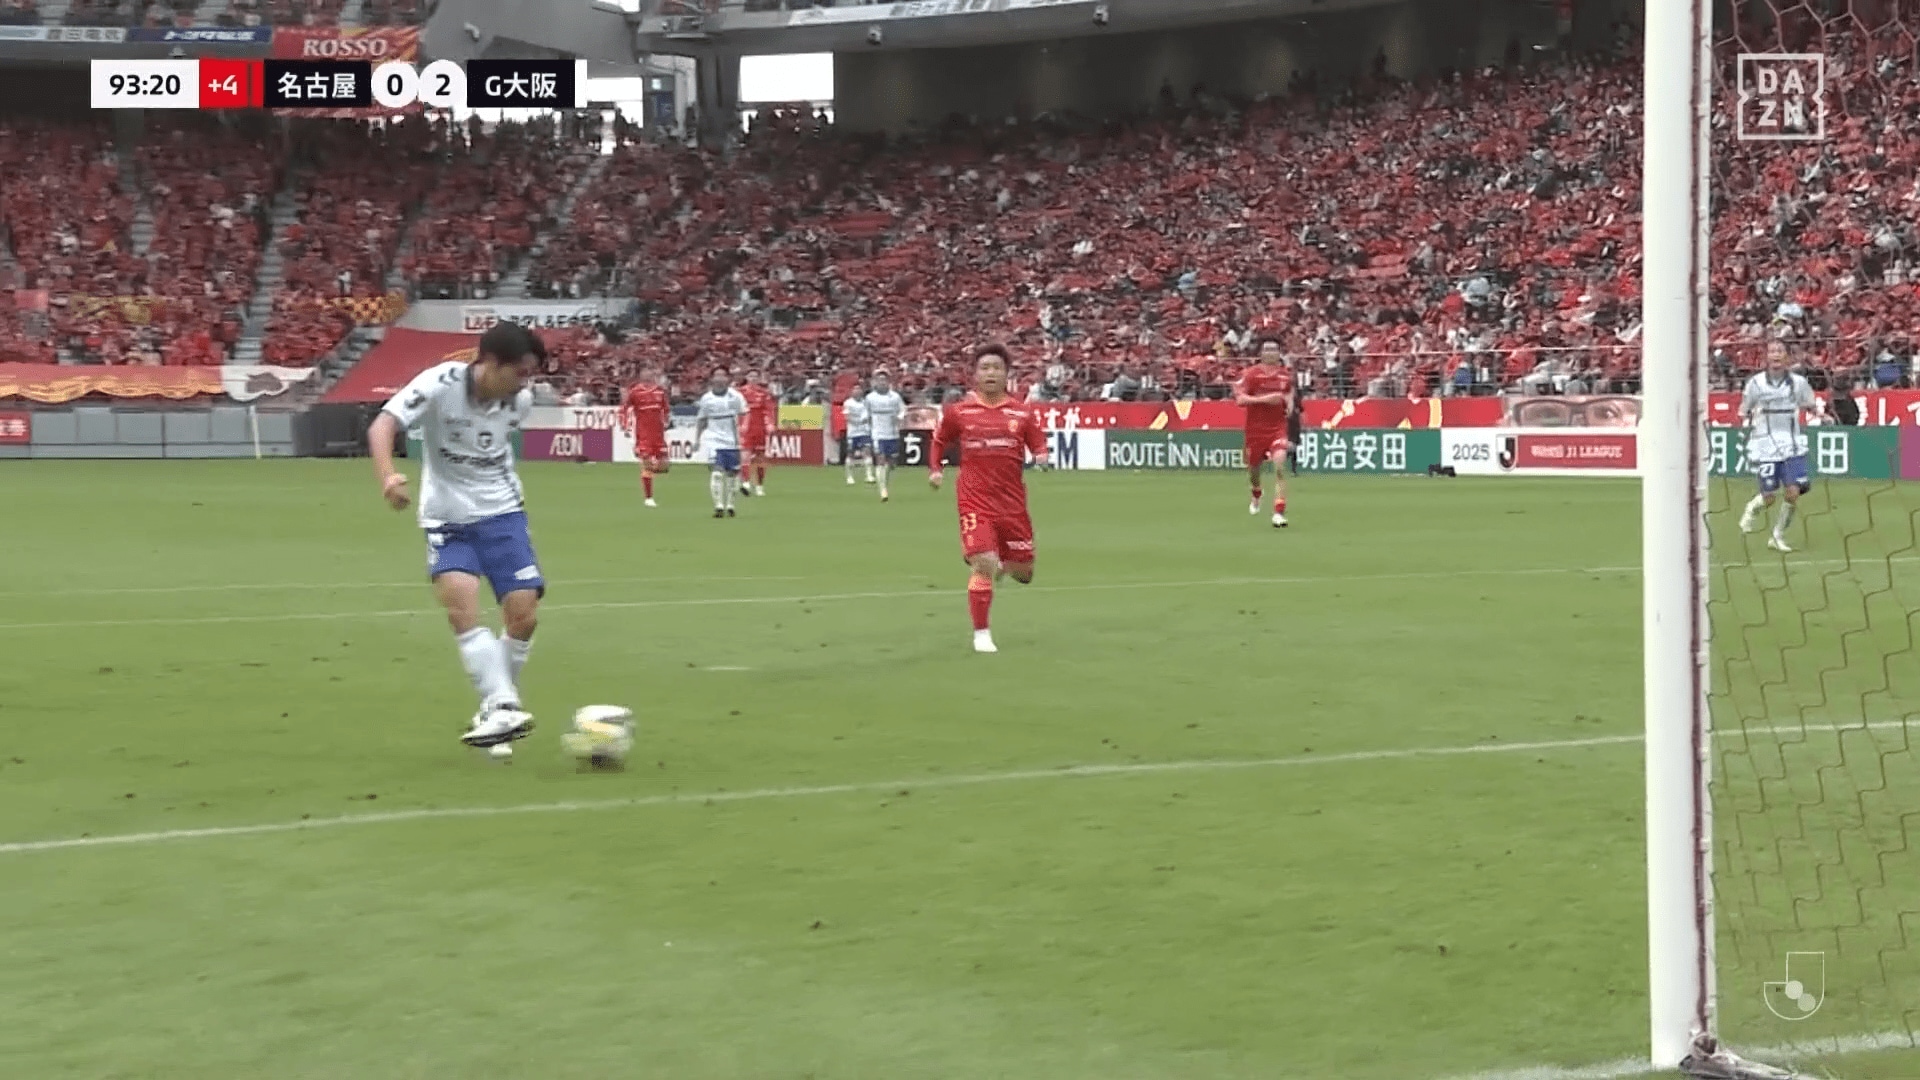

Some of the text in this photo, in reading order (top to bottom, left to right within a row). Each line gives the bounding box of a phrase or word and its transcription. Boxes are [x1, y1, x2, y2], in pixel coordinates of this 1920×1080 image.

[303, 37, 388, 57] ROSSO
[1109, 442, 1165, 467] ROUTE
[1203, 449, 1248, 469] HOTEL
[1297, 432, 1407, 470] 明治安田
[1452, 443, 1491, 461] 2025
